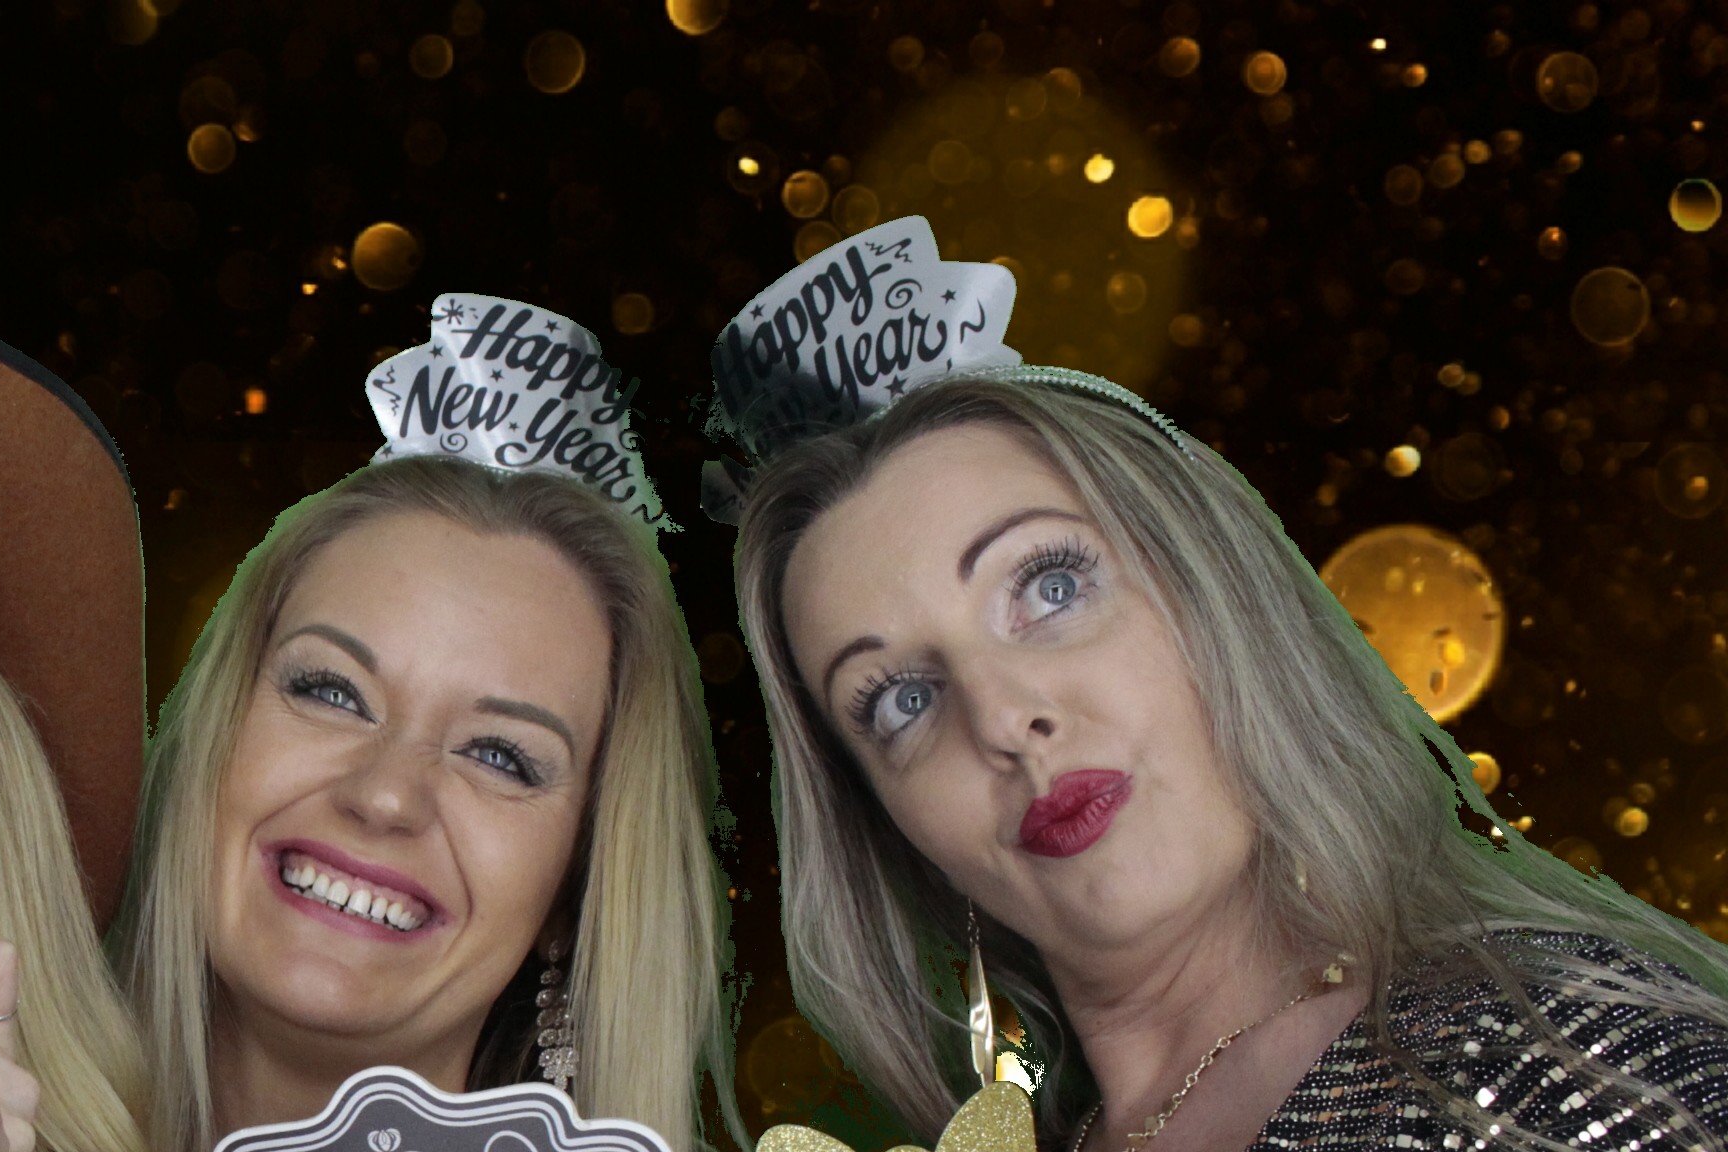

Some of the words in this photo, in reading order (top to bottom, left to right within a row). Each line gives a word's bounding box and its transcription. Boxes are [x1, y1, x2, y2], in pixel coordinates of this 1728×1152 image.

[452, 303, 641, 425] Happy
[814, 308, 948, 418] Year
[399, 366, 519, 438] New
[495, 398, 636, 503] Year
